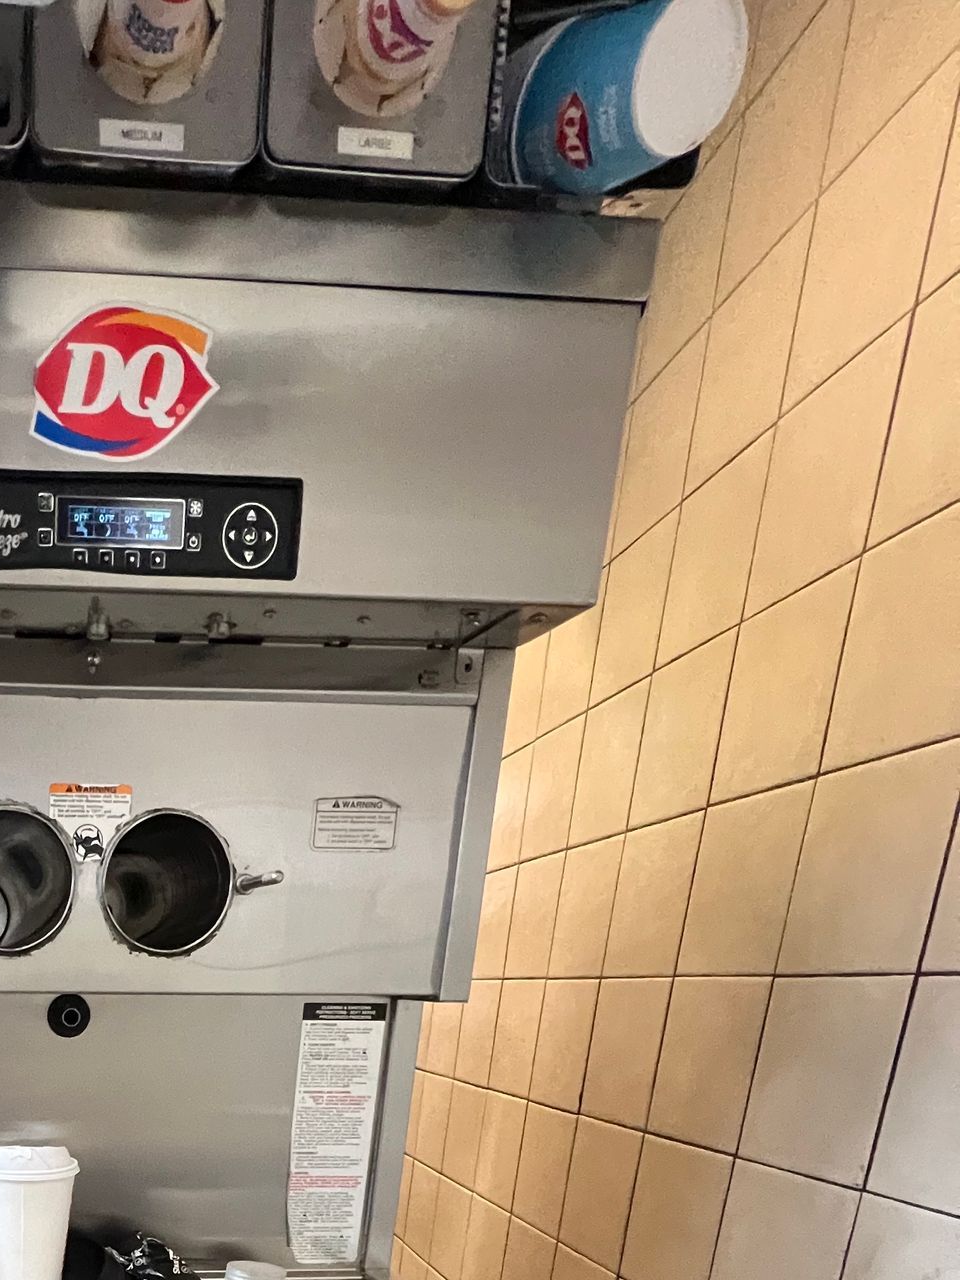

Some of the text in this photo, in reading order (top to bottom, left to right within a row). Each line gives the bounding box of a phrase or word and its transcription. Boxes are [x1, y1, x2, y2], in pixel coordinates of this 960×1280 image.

[57, 342, 185, 429] DQ
[99, 514, 115, 523] OFF
[74, 785, 117, 793] WARNING
[342, 801, 383, 809] WARNING
